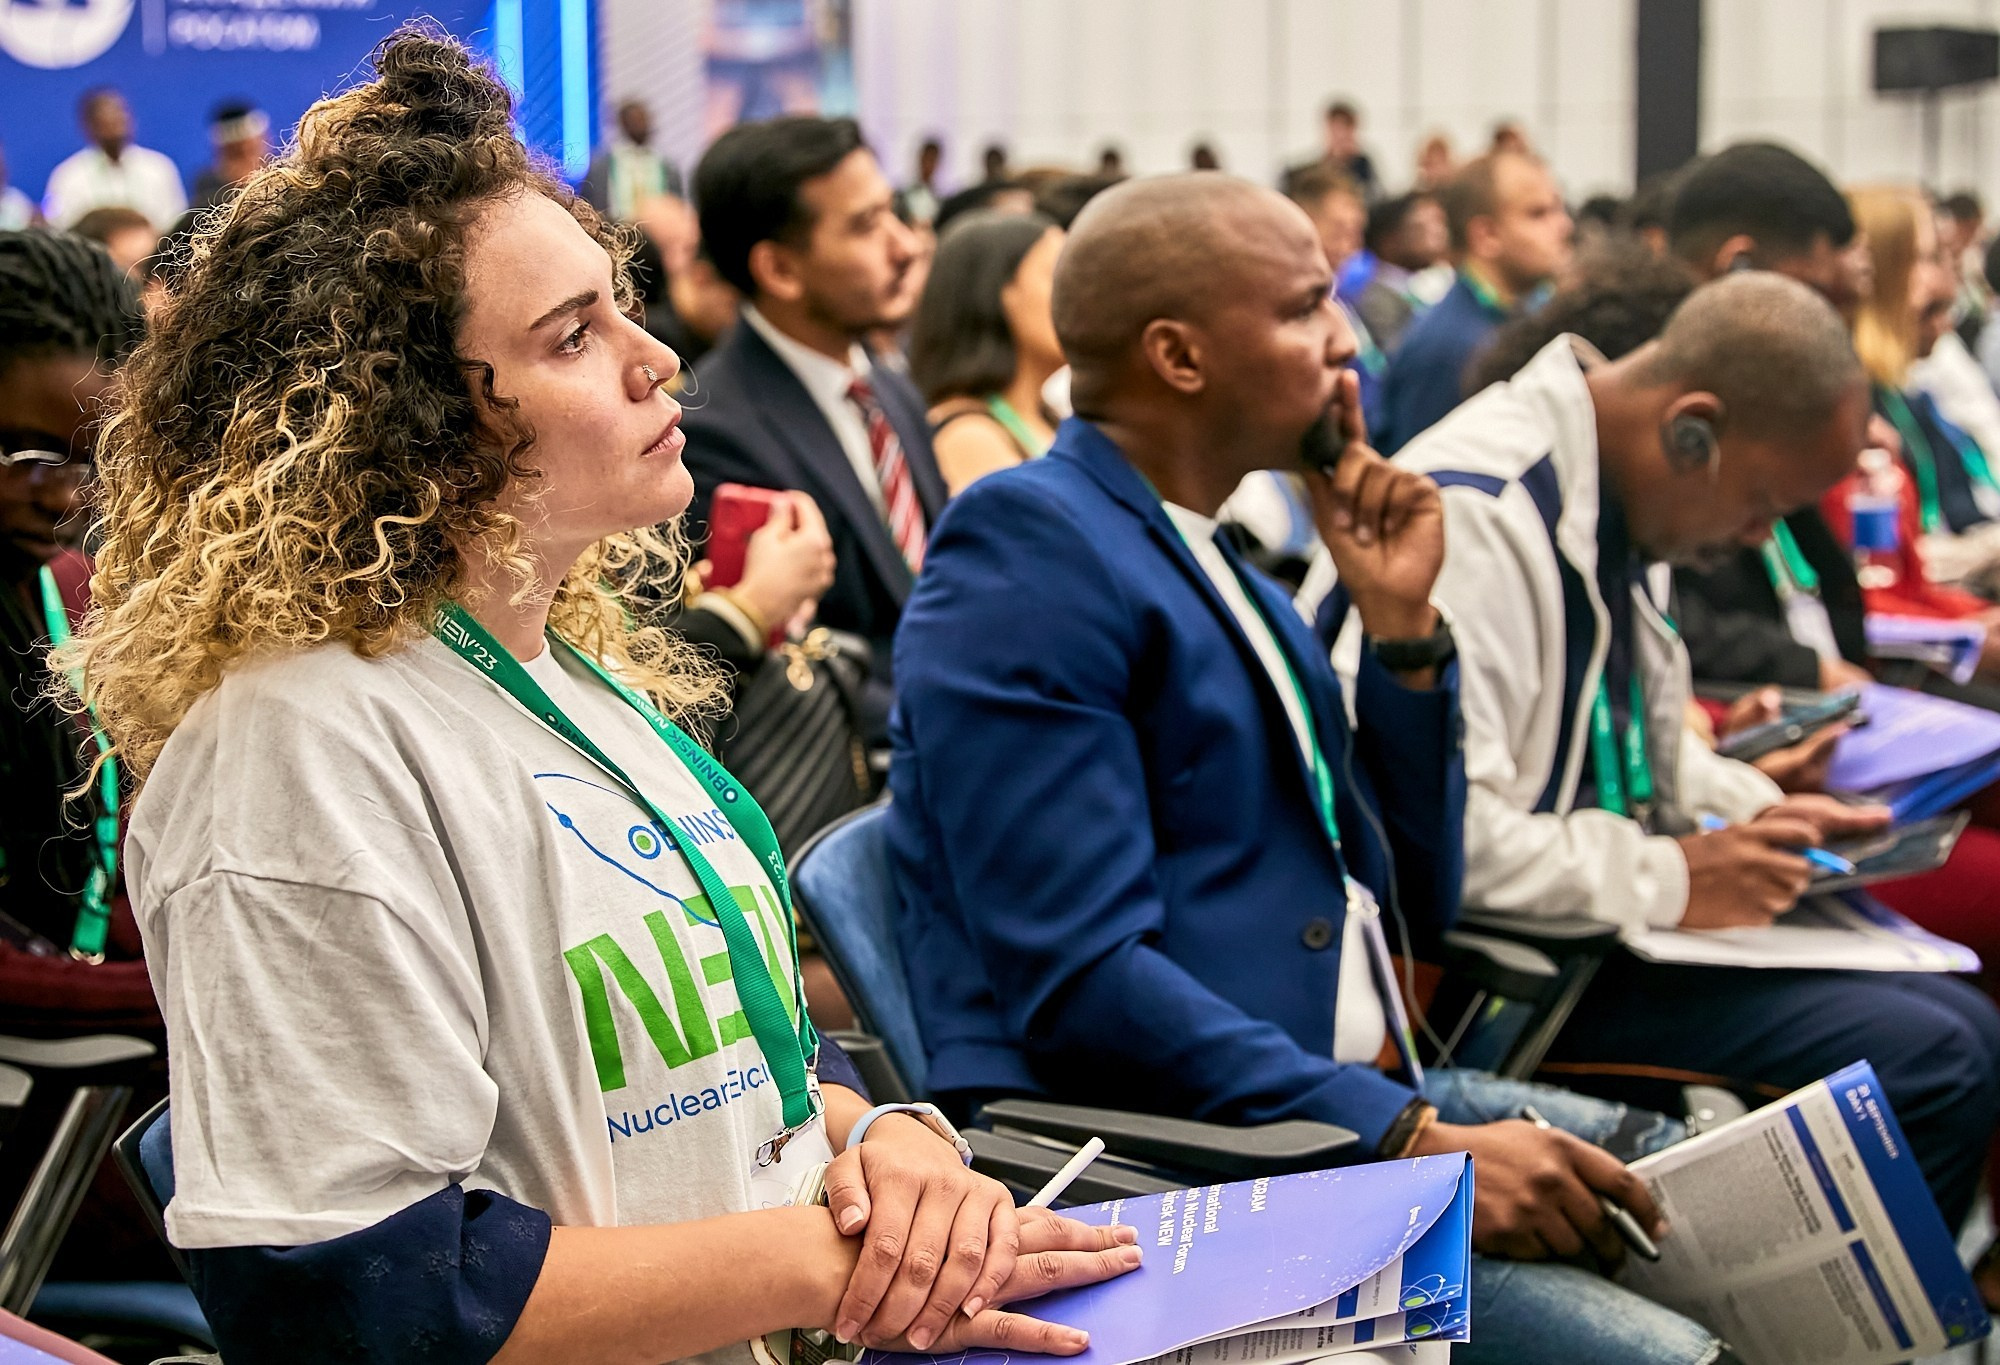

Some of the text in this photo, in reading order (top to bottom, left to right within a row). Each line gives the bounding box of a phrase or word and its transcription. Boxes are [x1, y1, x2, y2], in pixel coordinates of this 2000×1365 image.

[668, 729, 738, 804] OBNINSK
[1157, 1218, 1175, 1246] NEW
[1180, 1202, 1199, 1244] Nuclear
[1172, 1241, 1193, 1275] Forum
